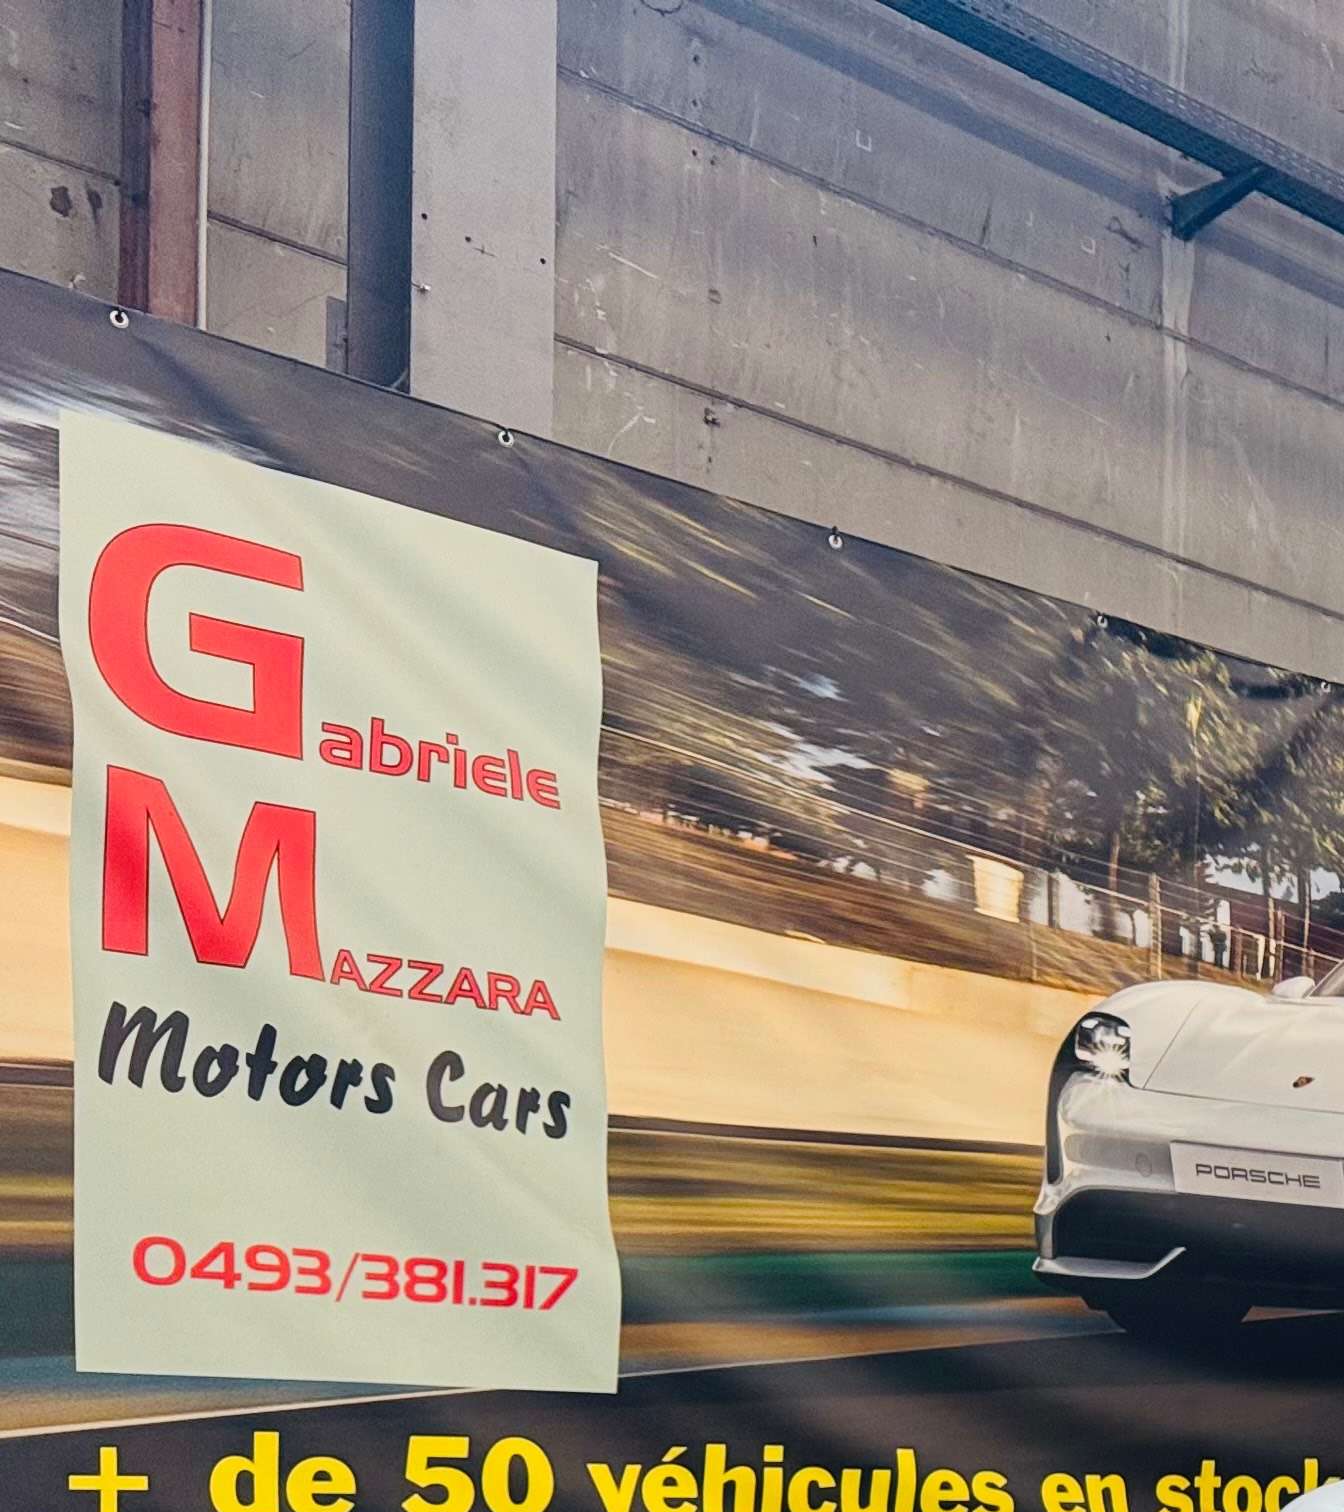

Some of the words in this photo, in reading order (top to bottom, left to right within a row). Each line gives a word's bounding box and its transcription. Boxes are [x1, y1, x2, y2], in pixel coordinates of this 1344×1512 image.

[98, 1001, 395, 1114] Motors
[426, 1050, 571, 1139] Cars
[1195, 1163, 1321, 1189] PORSCHE
[131, 1235, 579, 1312] 0493/381.317
